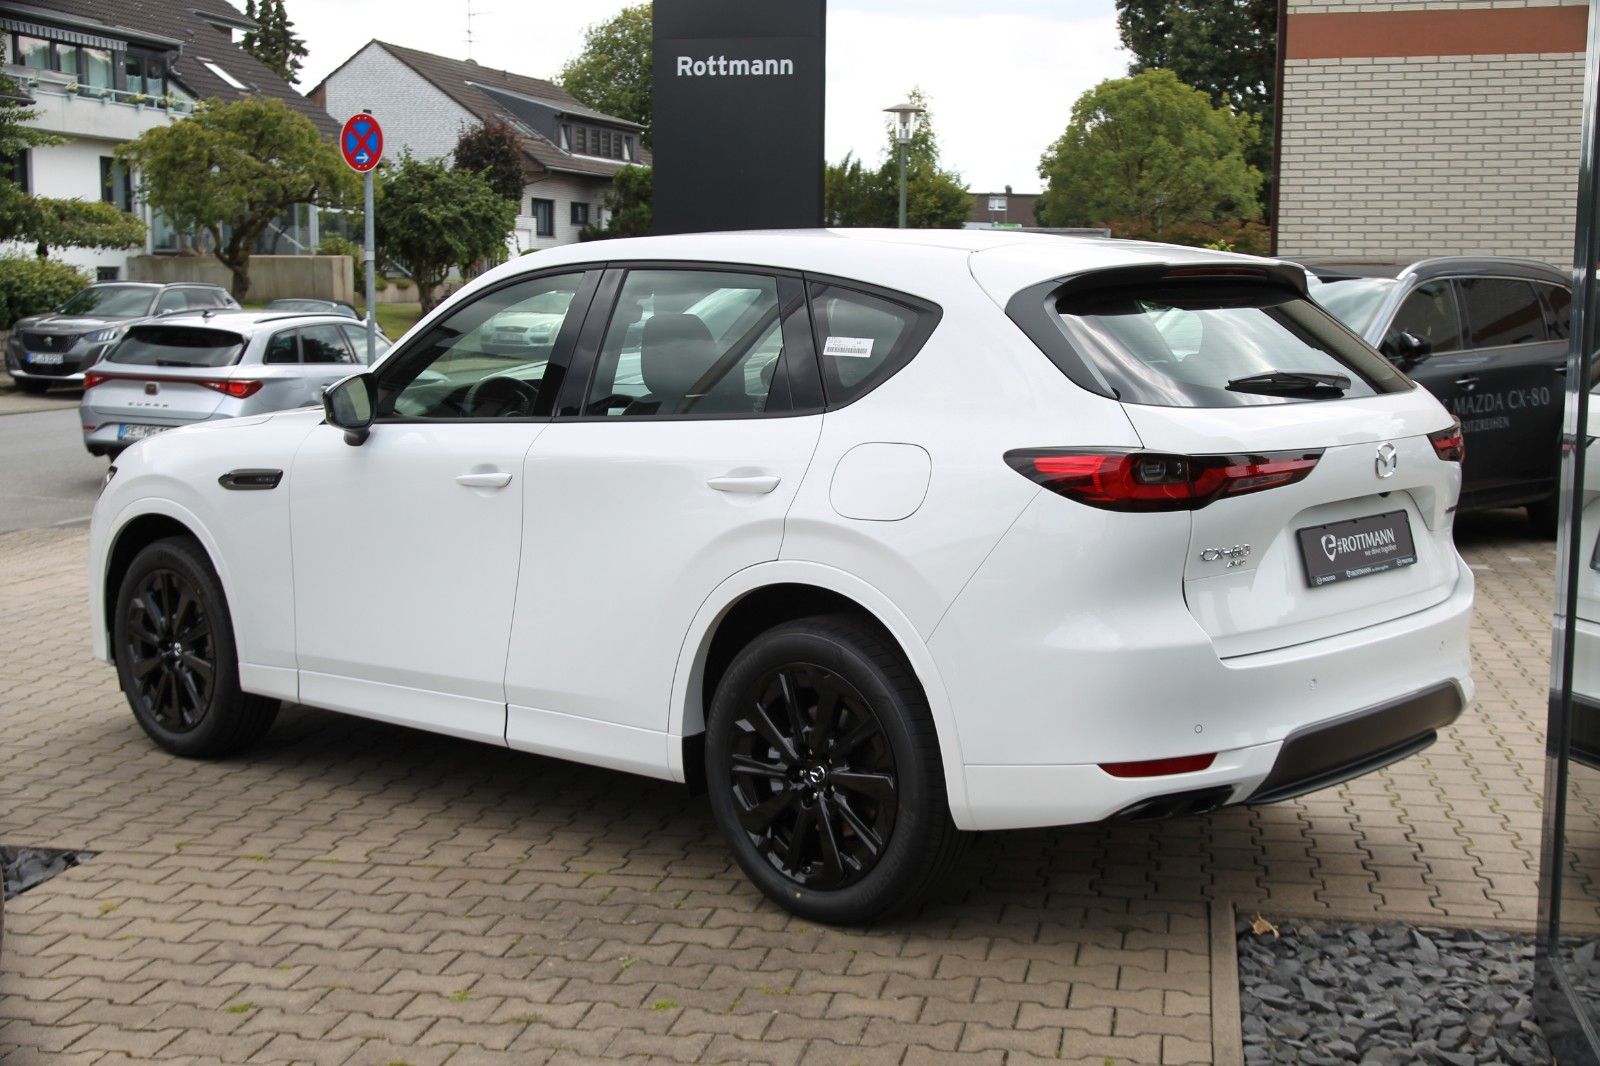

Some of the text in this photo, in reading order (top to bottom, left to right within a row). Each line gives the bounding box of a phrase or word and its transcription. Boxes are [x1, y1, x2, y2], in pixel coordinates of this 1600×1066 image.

[677, 55, 794, 76] Rottmann
[1453, 392, 1504, 414] MAZDA
[1508, 386, 1550, 409] CX-80
[1200, 543, 1250, 561] CX-60
